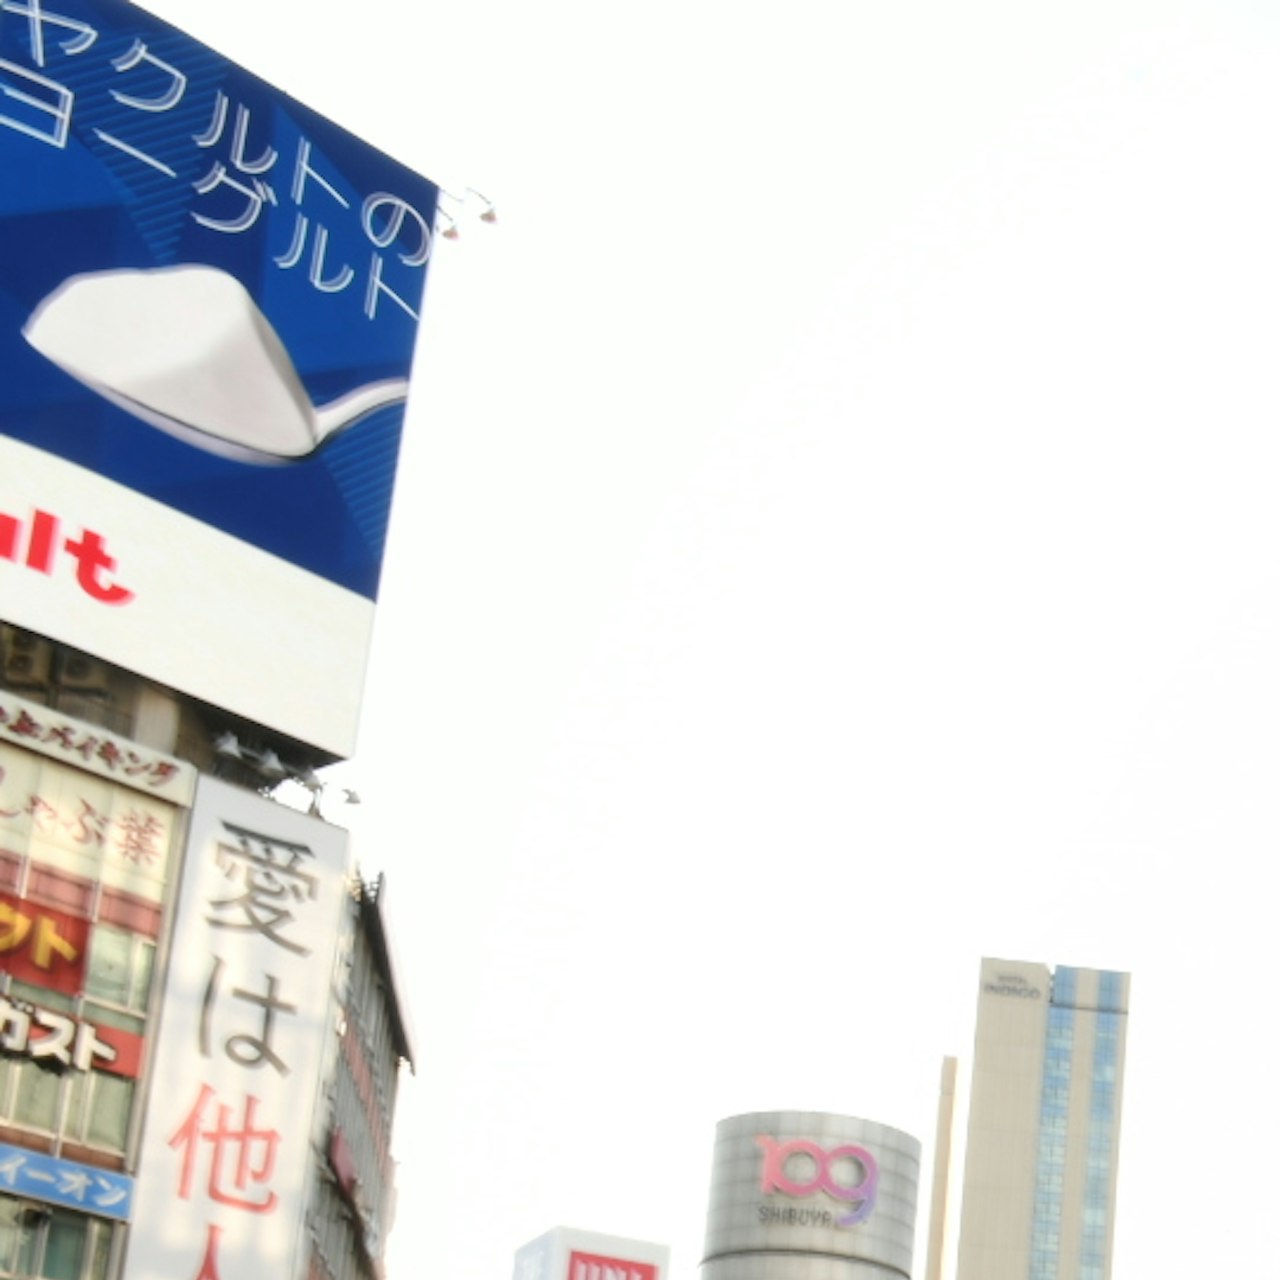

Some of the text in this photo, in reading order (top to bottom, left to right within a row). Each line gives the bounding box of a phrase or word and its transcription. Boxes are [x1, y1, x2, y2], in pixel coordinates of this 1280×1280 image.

[0, 58, 420, 321] ヨーグルト
[0, 704, 181, 787] バイキング
[752, 1131, 881, 1229] 109
[757, 1204, 834, 1229] SHIBUYA
